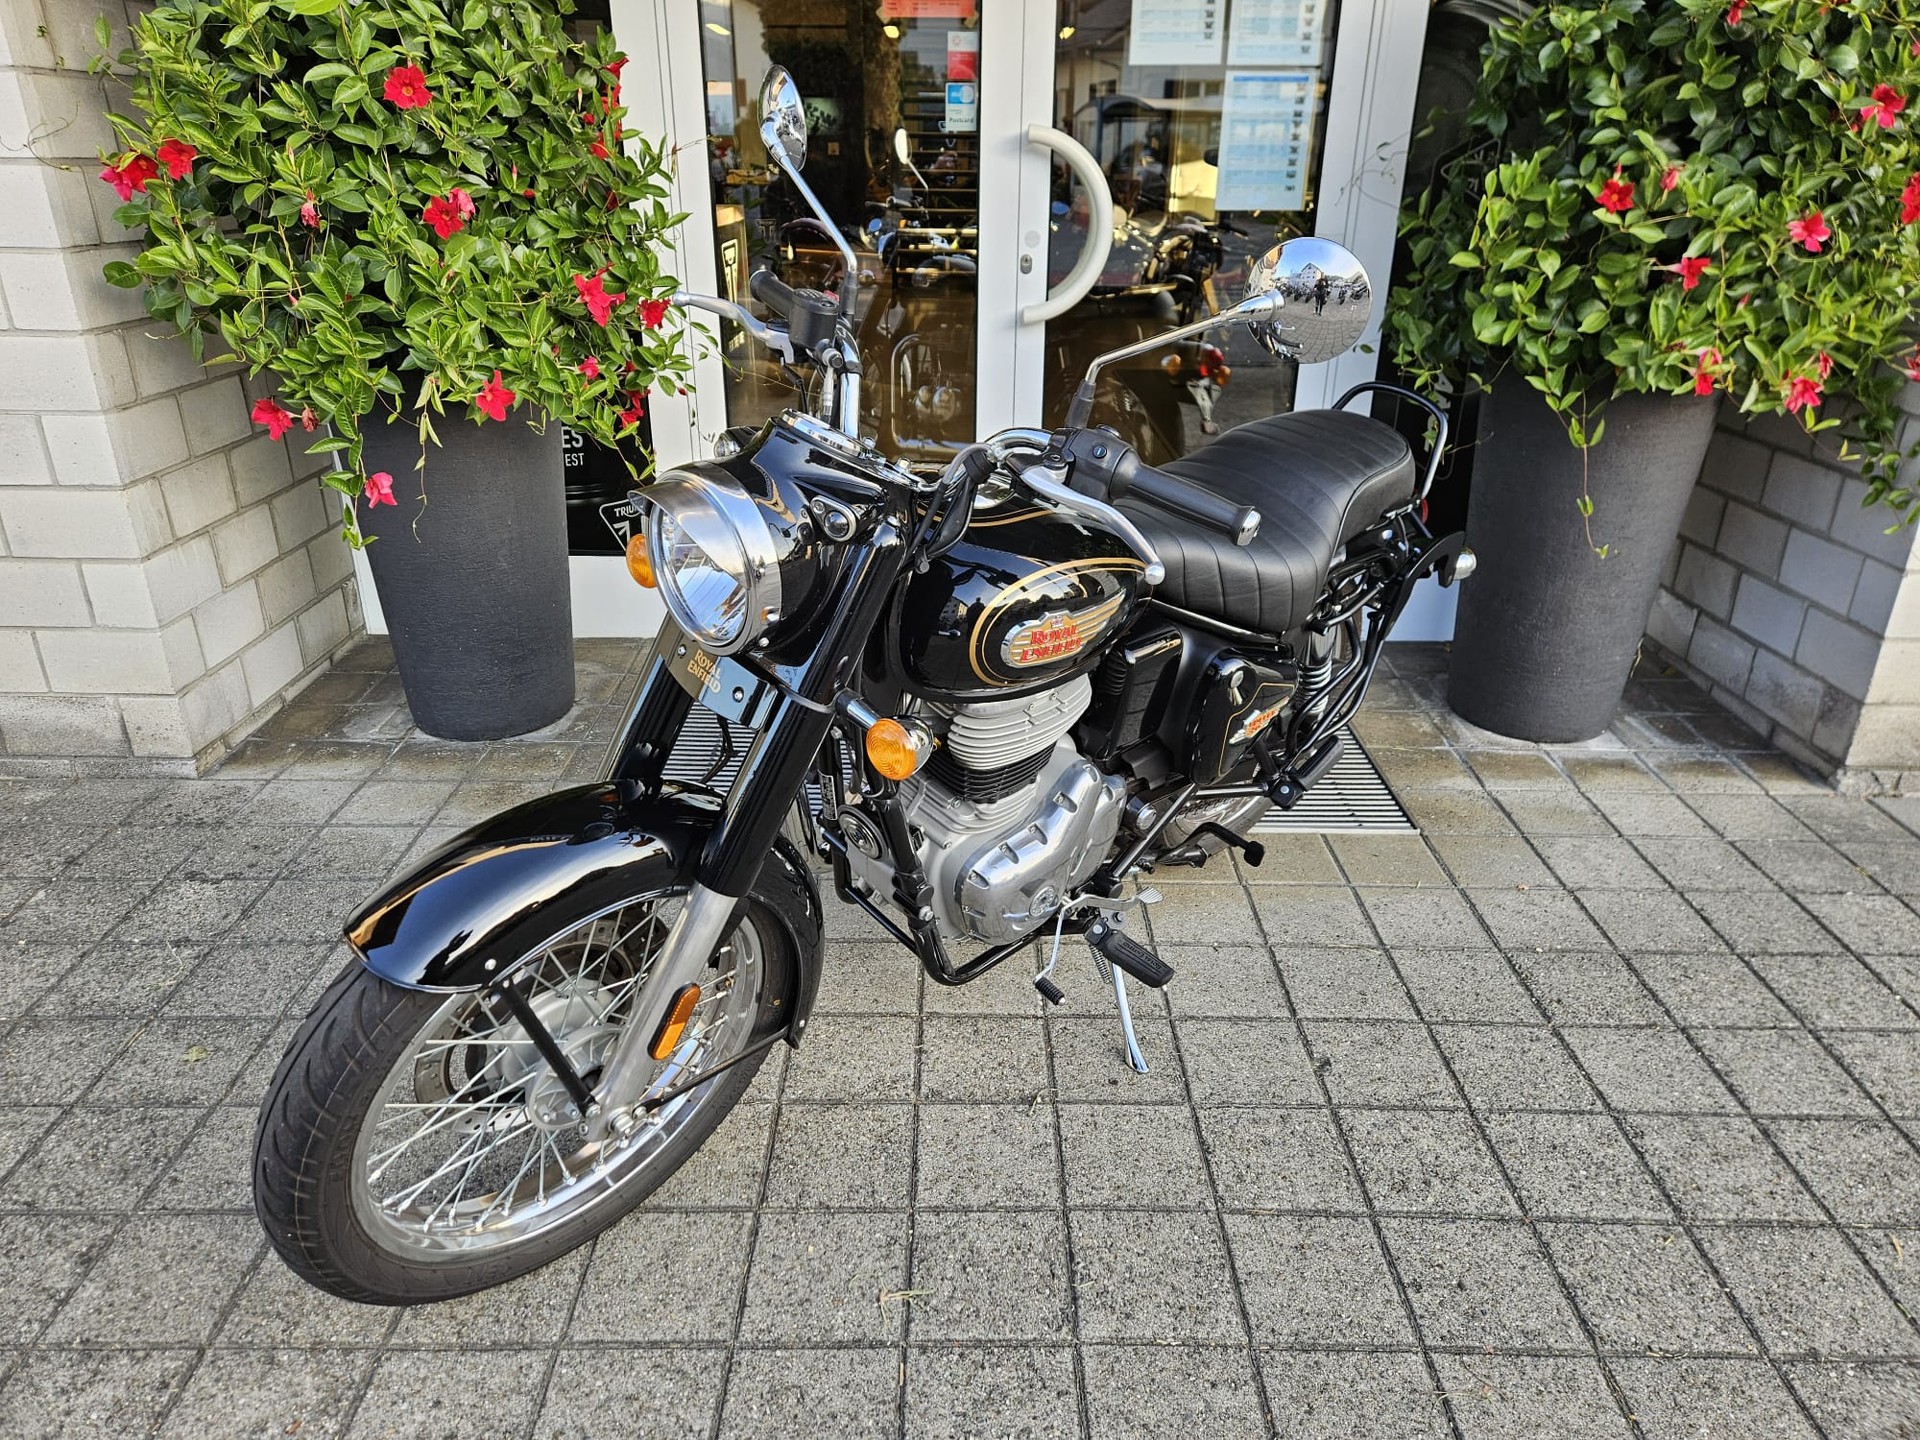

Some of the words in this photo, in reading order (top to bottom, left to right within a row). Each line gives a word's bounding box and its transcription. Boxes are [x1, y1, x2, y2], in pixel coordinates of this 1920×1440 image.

[614, 503, 637, 517] TRIU
[1030, 625, 1078, 646] ROYAL
[1021, 637, 1083, 663] ENFIELD
[687, 660, 722, 693] ENFIELD
[694, 649, 721, 678] ROYAL
